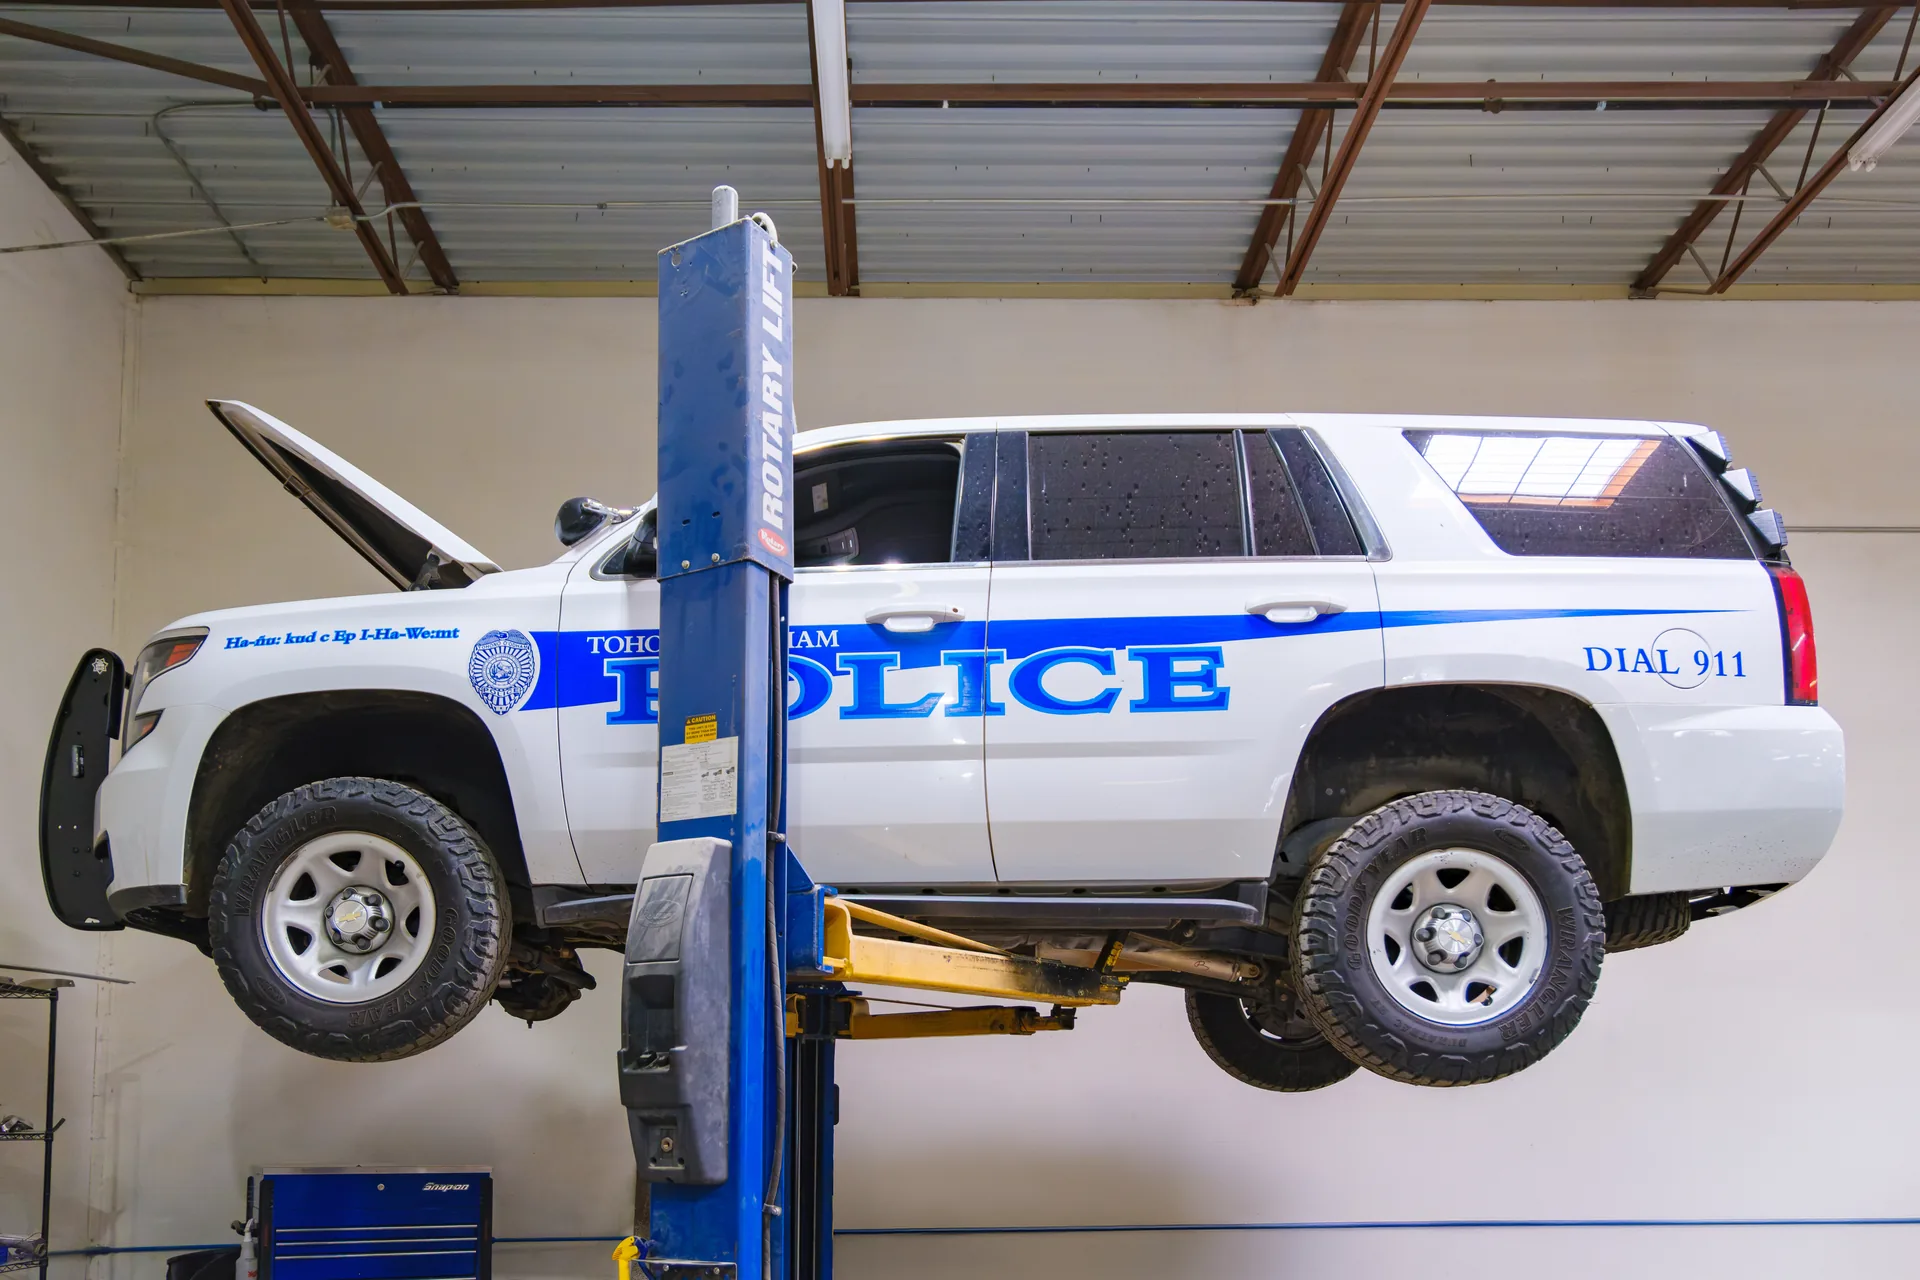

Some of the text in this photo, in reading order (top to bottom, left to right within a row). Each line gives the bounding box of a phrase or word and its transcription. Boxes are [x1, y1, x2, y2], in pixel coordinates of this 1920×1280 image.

[762, 239, 783, 531] ROTARY LIFT
[283, 631, 318, 645] kud
[319, 633, 330, 643] c
[332, 630, 357, 645] Ep
[359, 626, 460, 641] I-Ha-We:mt
[1582, 646, 1747, 678] DIAL 911
[691, 714, 716, 723] CAUTION
[232, 804, 338, 918] WRANGLER
[1497, 904, 1576, 1042] WRANGLER
